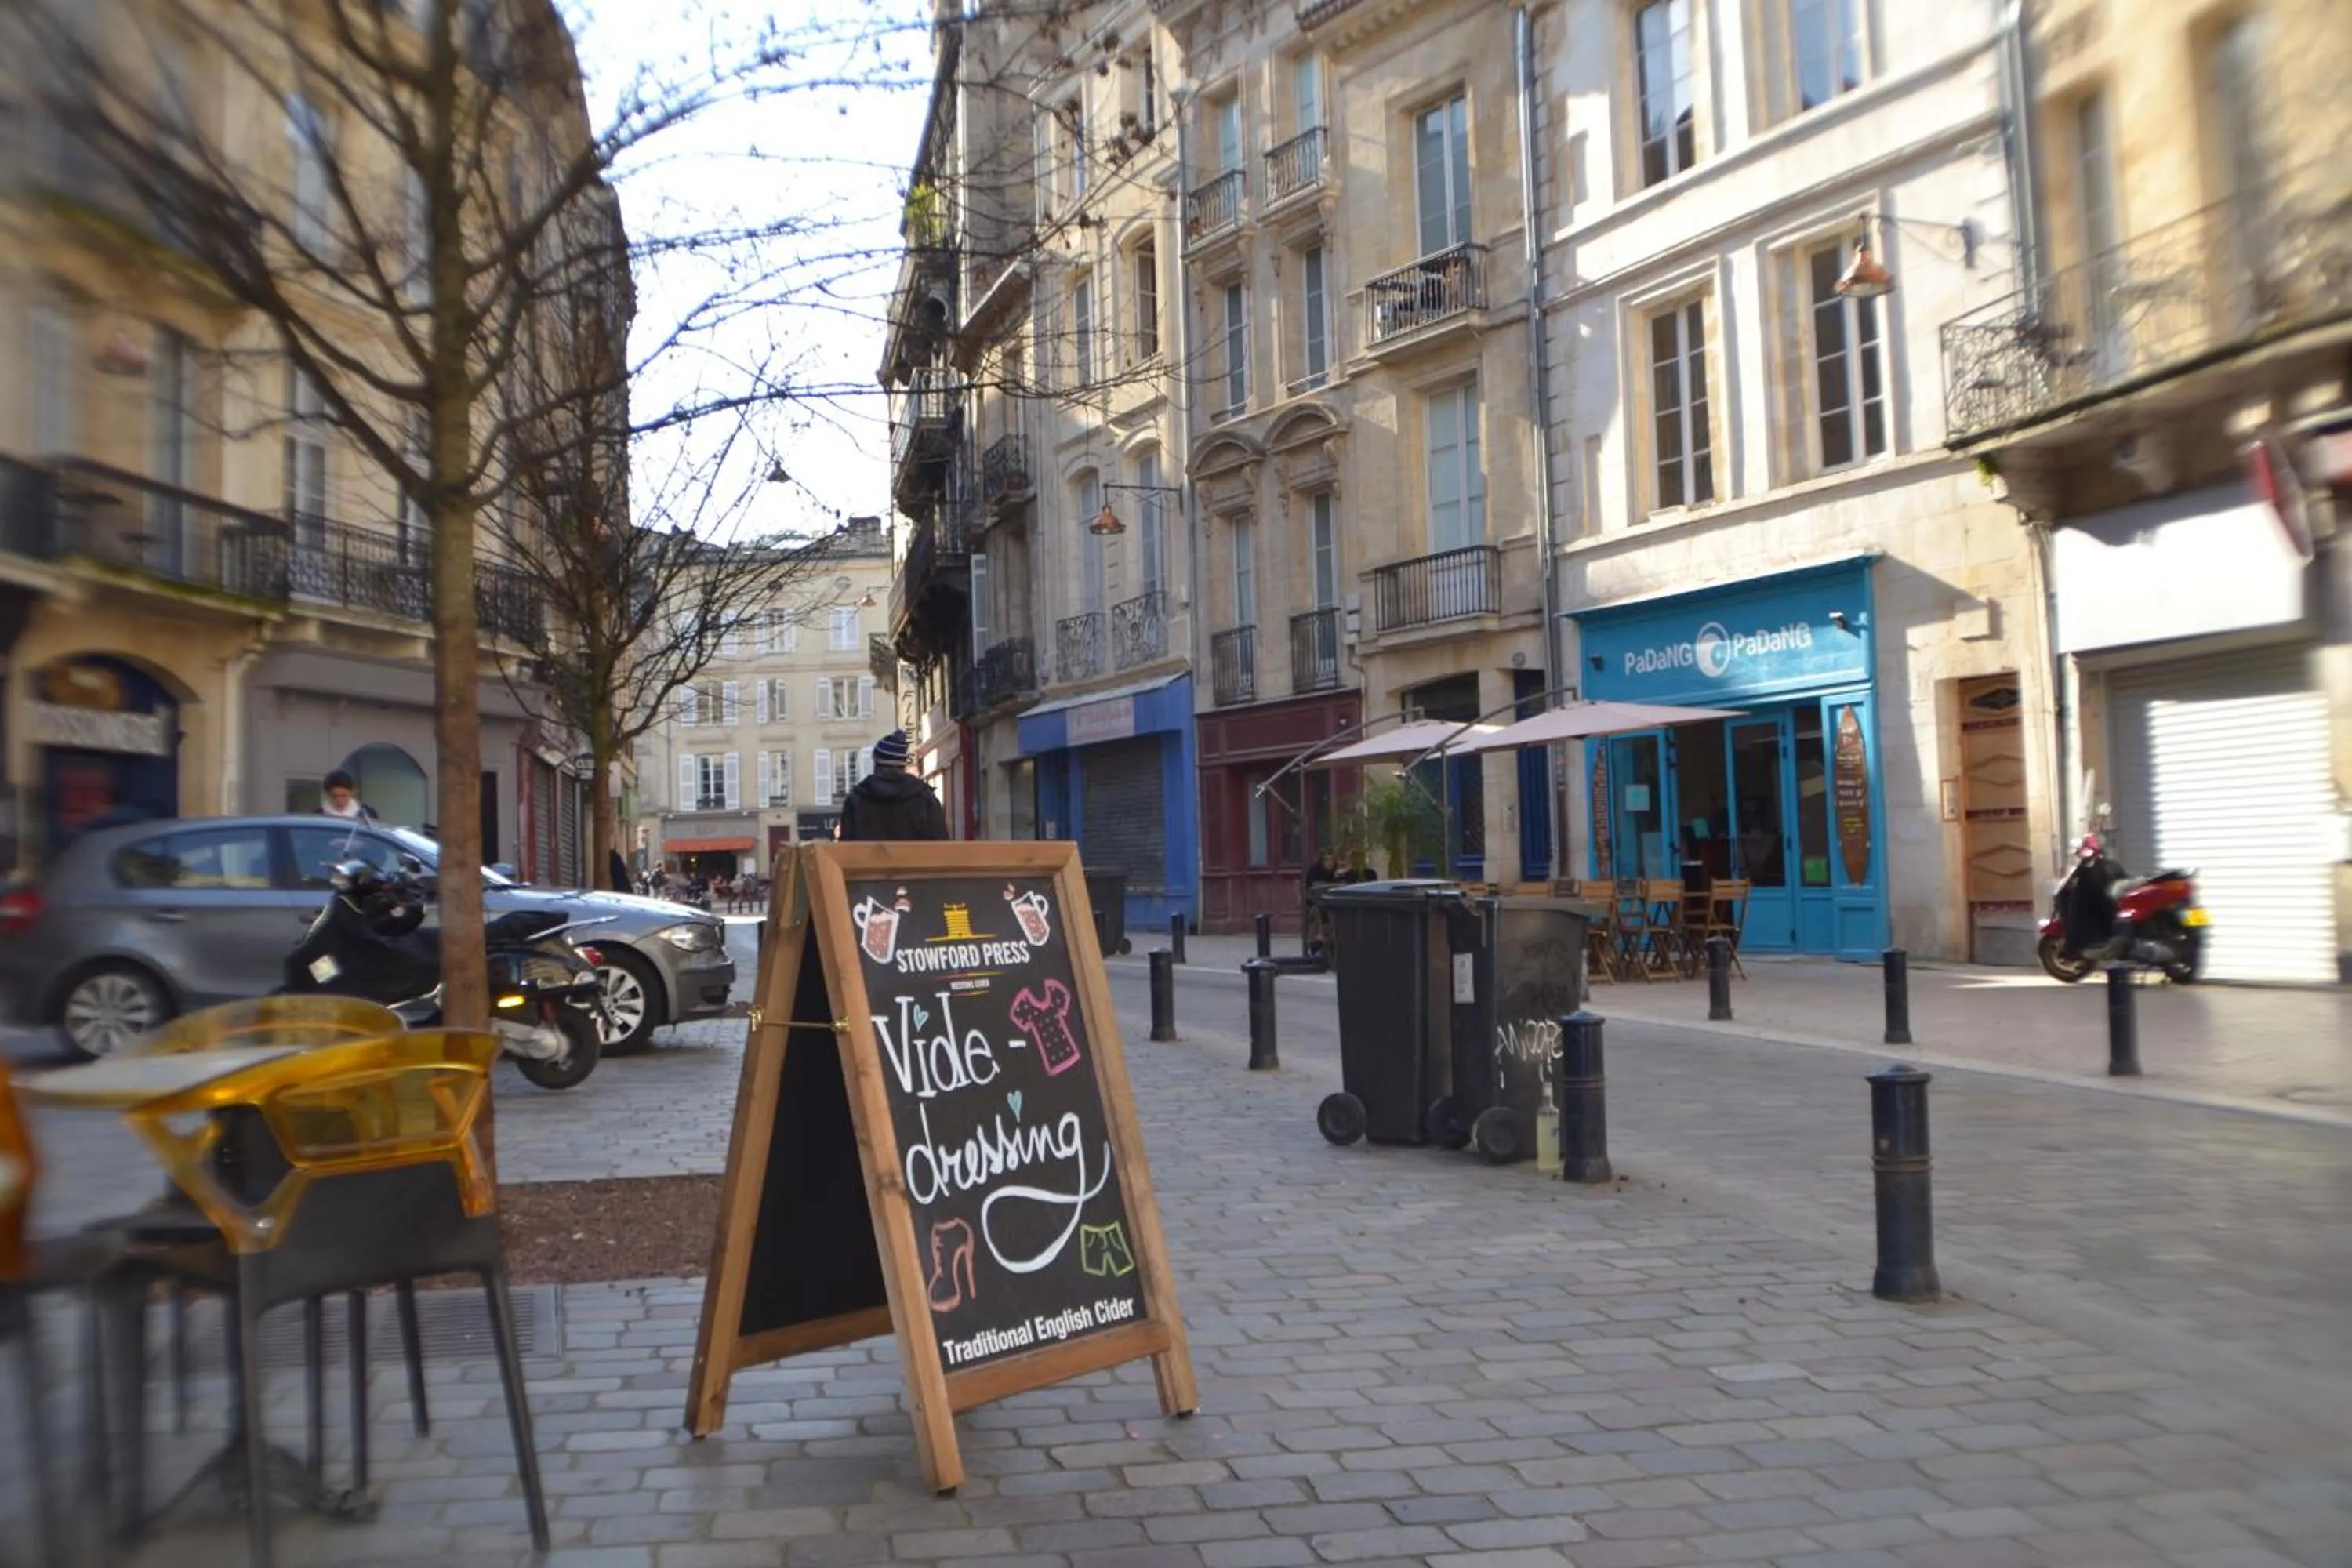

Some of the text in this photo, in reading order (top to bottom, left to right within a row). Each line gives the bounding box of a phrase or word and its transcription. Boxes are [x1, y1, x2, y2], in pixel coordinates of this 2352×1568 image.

[1624, 623, 1812, 675] PaDaNG PaDaNG
[895, 942, 1030, 973] STOWFORD PRESS
[906, 1102, 1110, 1272] dressing
[943, 1298, 1134, 1364] Traditional English Cider
